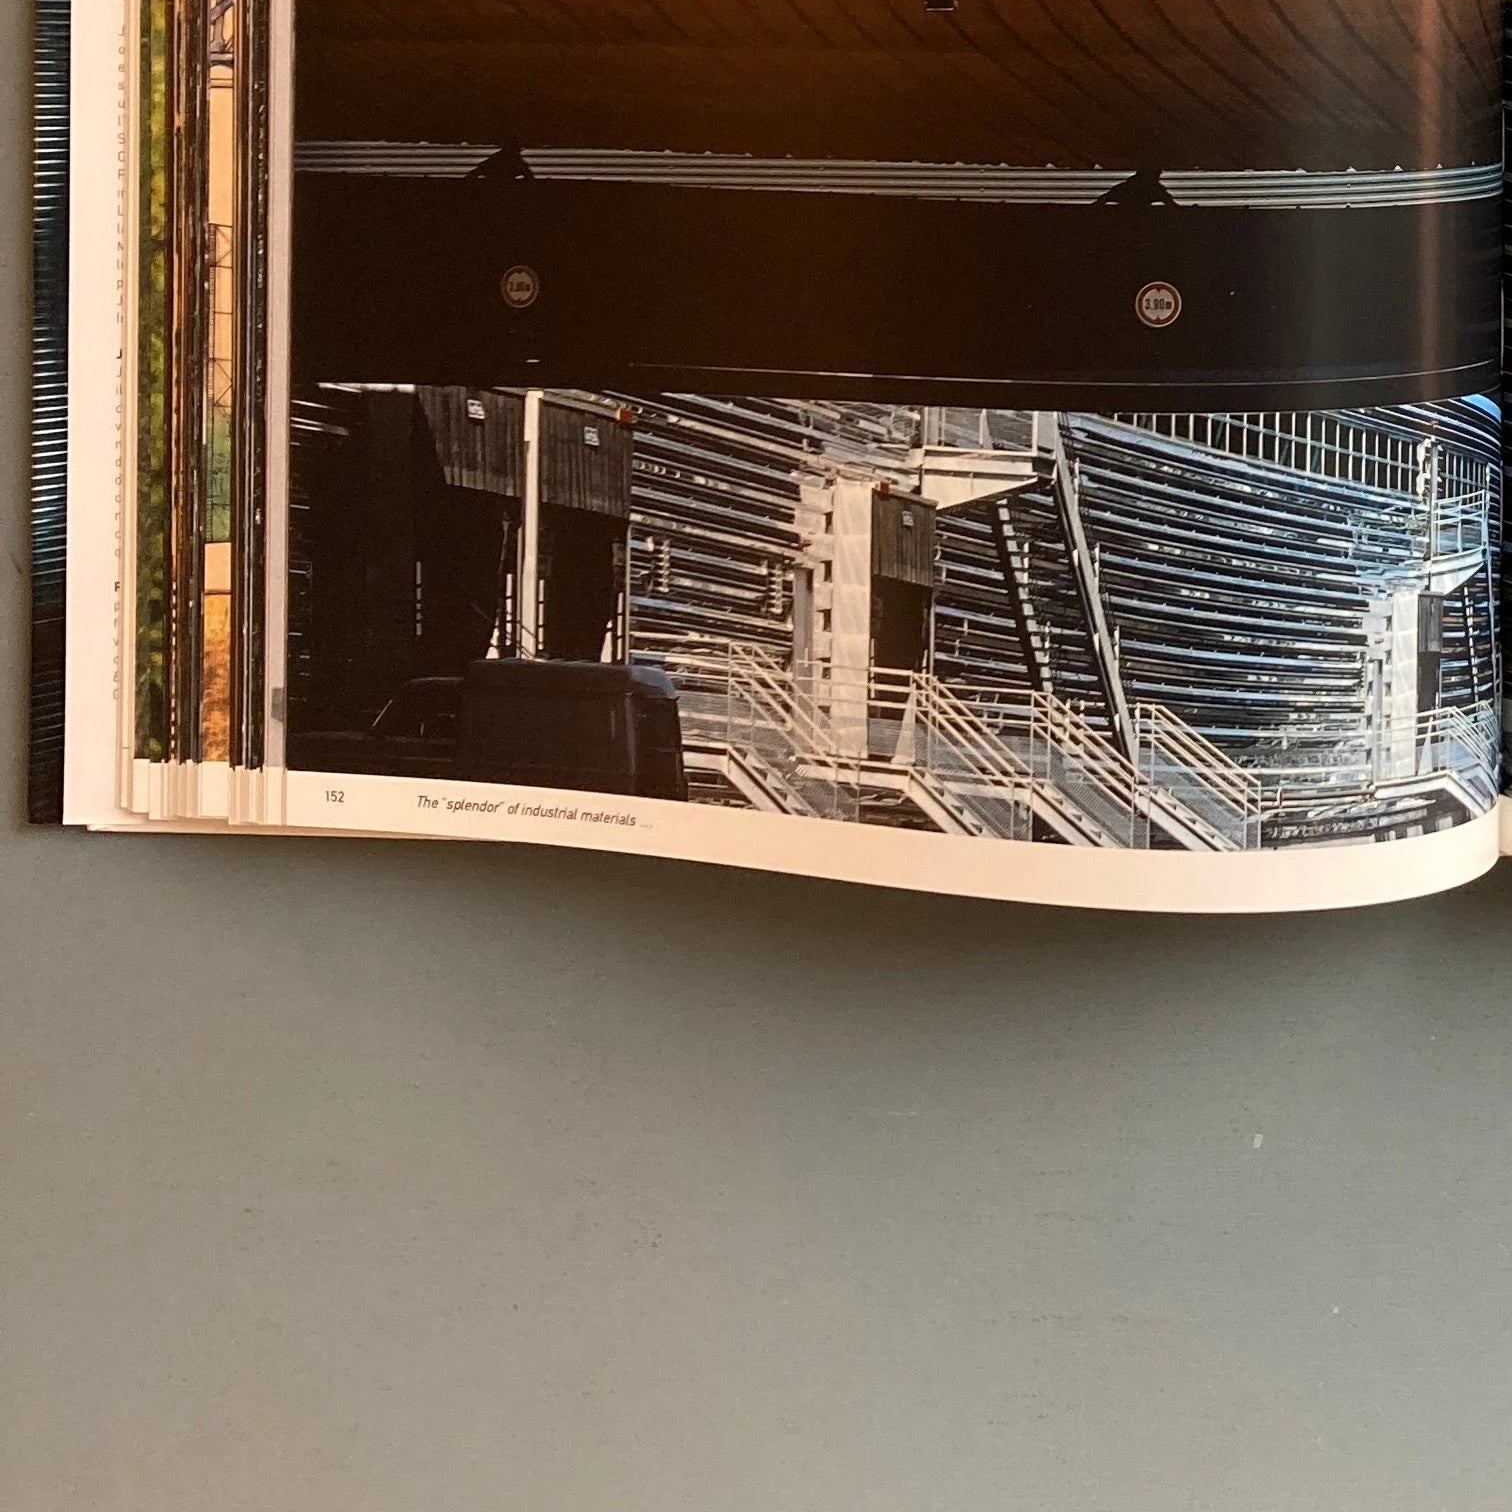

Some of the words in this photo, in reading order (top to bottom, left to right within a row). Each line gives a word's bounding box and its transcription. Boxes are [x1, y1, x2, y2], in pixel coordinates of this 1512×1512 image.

[325, 790, 345, 804] 152
[416, 795, 439, 809] The
[507, 802, 521, 815] of
[521, 804, 578, 821] industrial
[580, 811, 636, 827] materials
